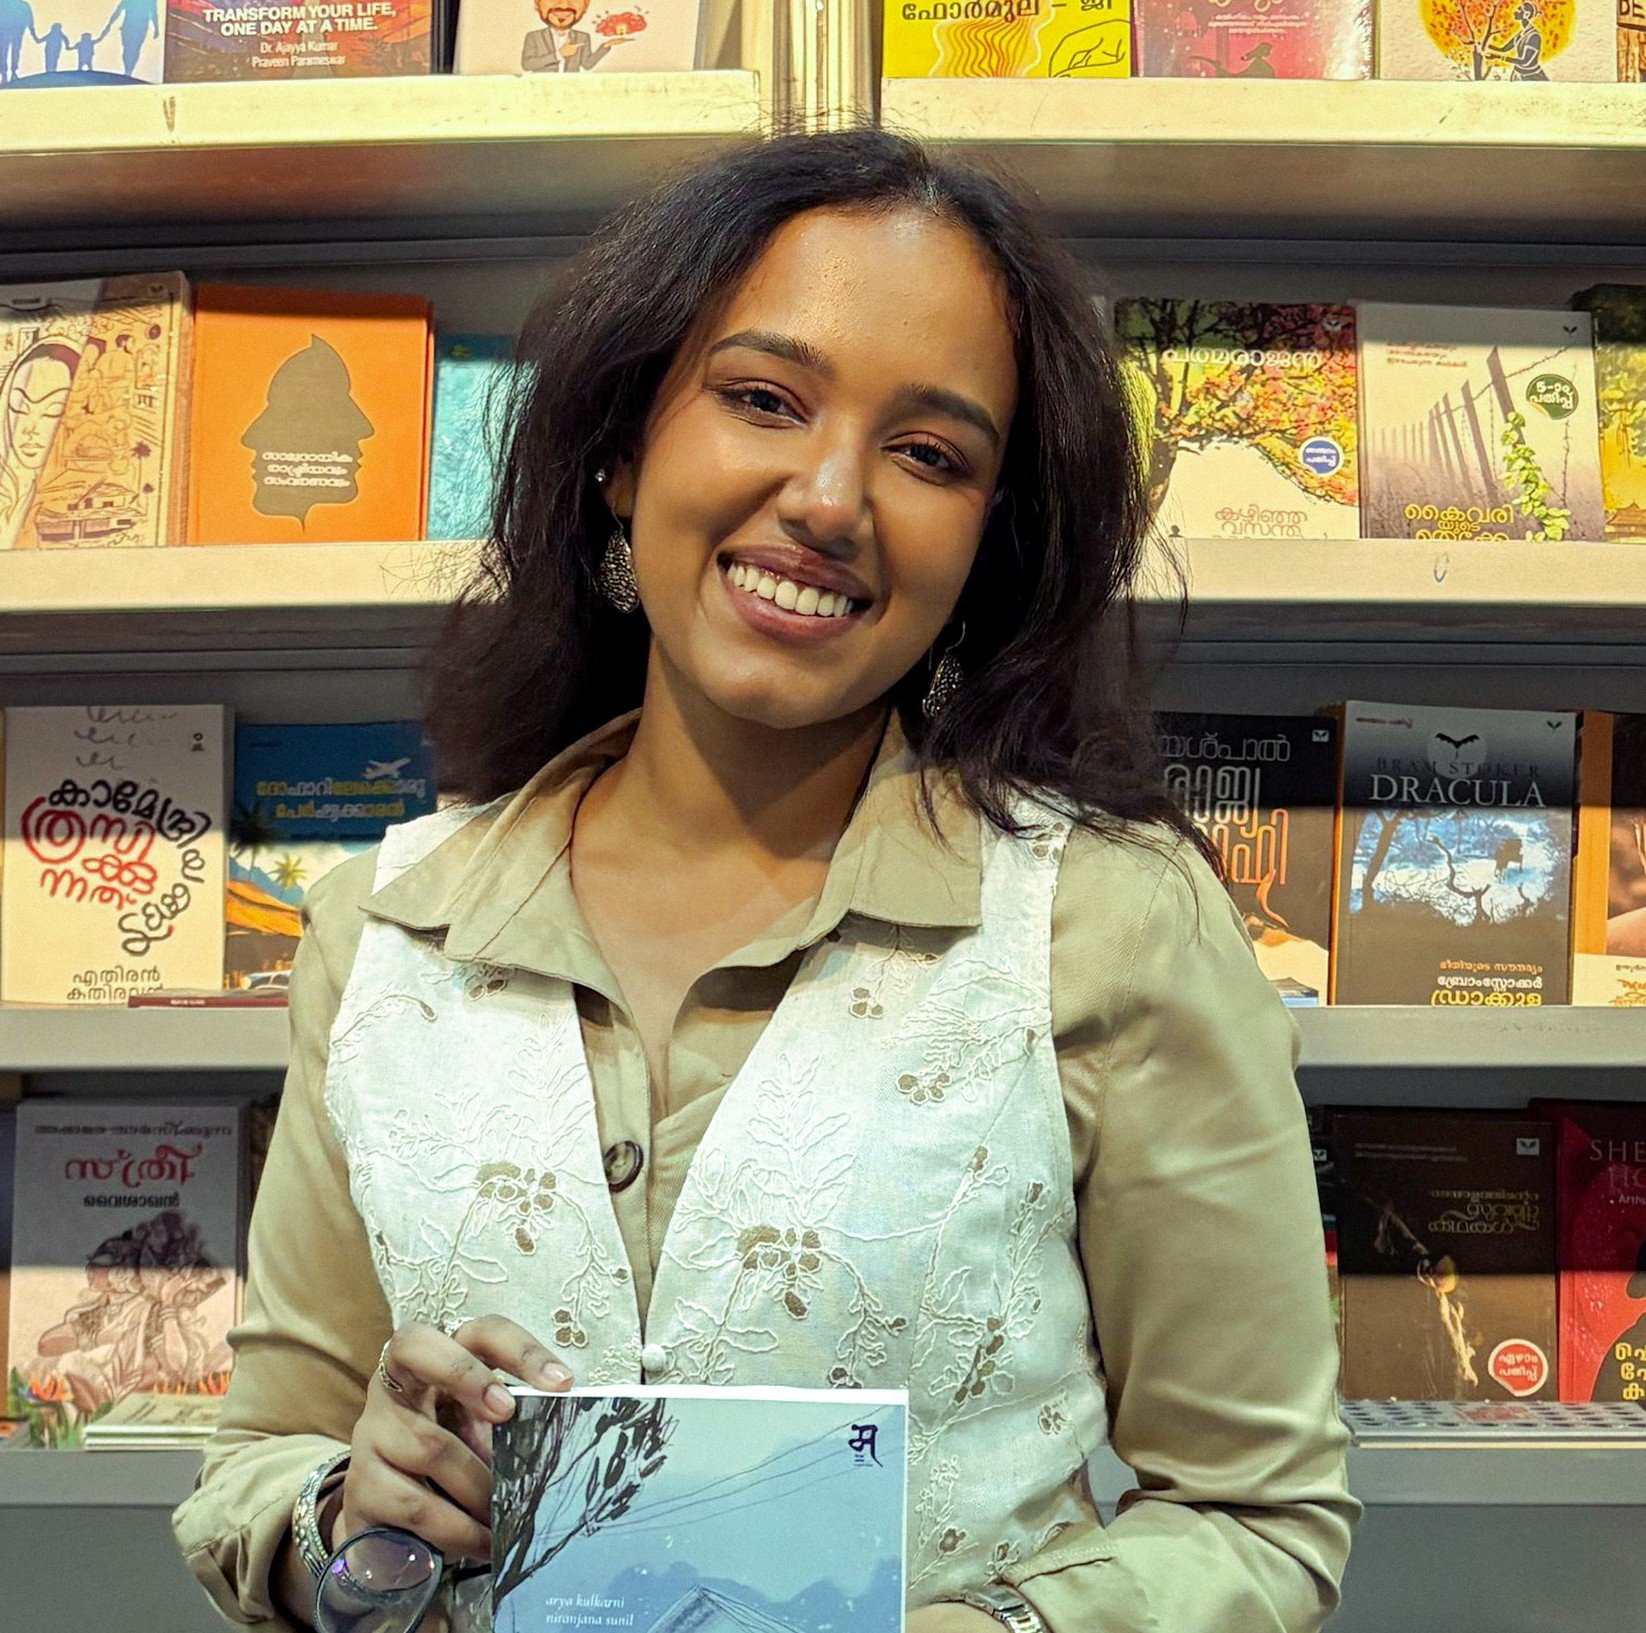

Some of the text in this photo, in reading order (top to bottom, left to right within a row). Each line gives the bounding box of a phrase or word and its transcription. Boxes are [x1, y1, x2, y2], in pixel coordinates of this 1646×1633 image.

[202, 2, 397, 22] TRANSFORM YOUR LIFE,
[221, 18, 379, 36] ONE DAY AT A TIME.
[307, 41, 338, 52] Kumar
[251, 56, 289, 68] Praveen
[1405, 503, 1514, 523] കൈവരി
[1369, 774, 1547, 808] DRACULA
[73, 965, 161, 986] എതിരൻ
[545, 1593, 625, 1610] arya kulkarni
[546, 1612, 634, 1628] niranjana sunil
